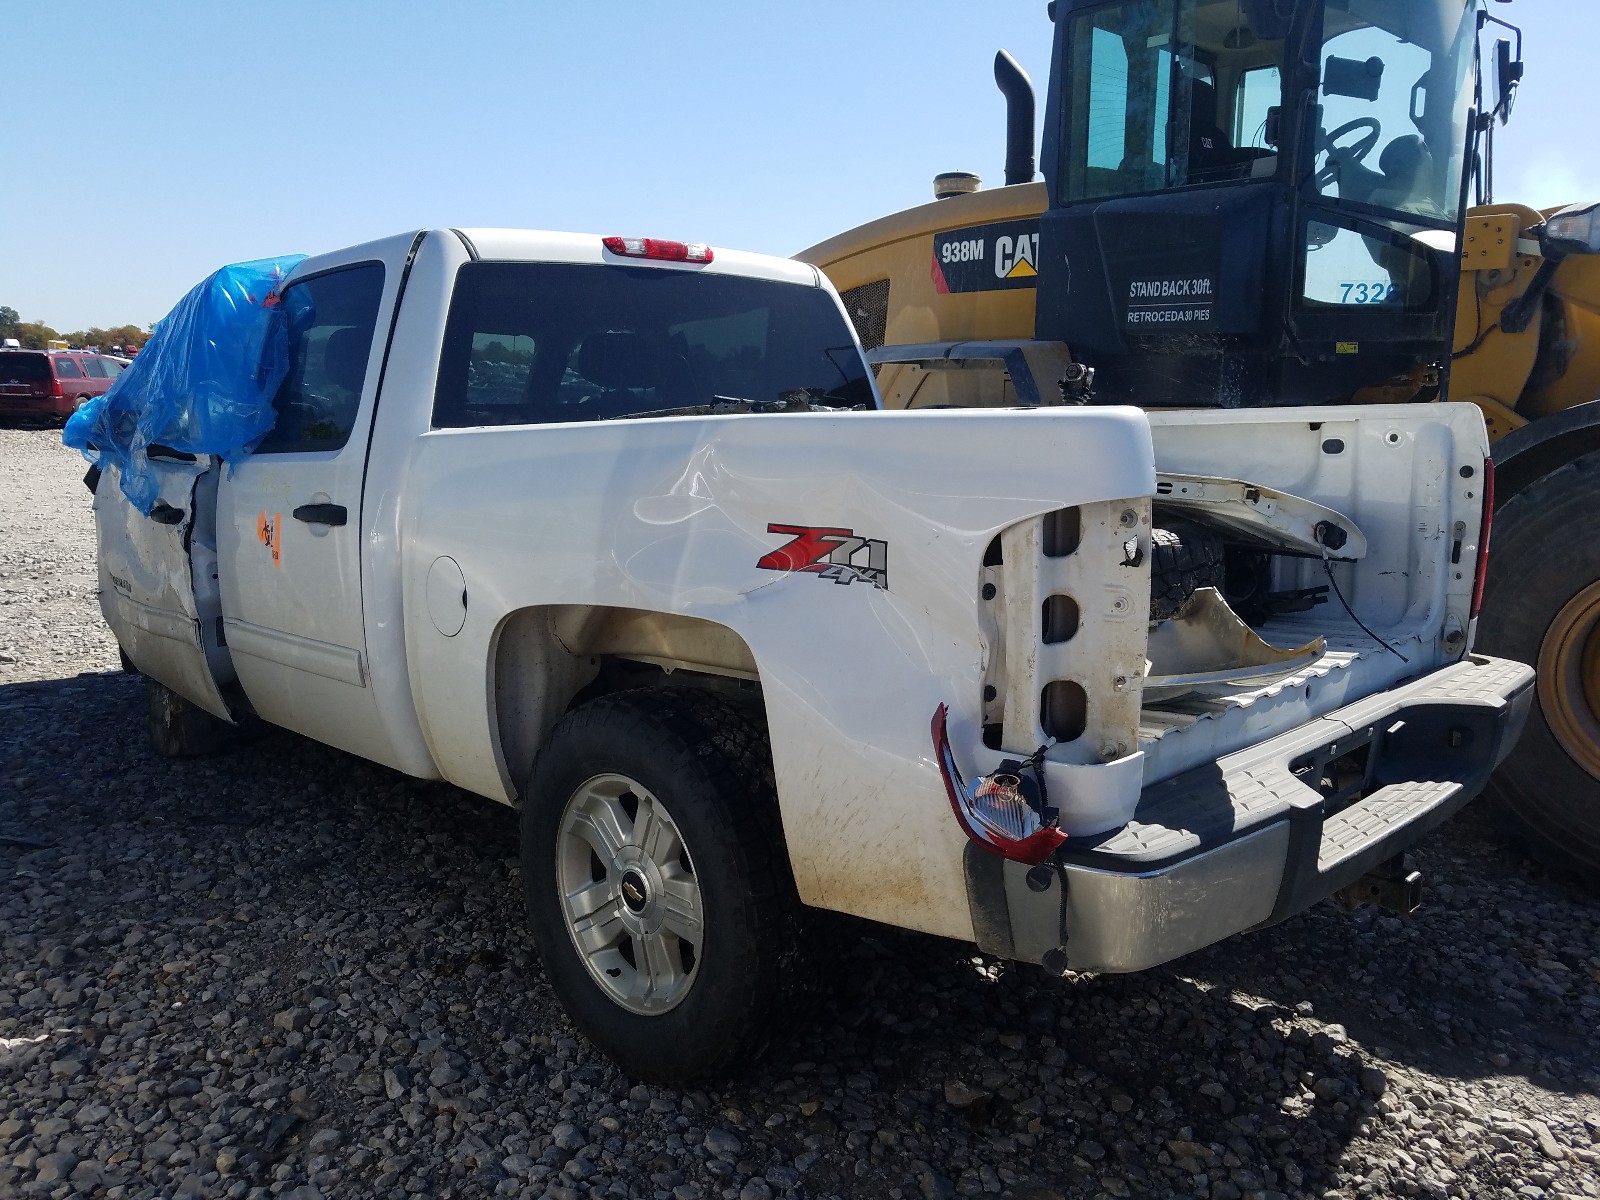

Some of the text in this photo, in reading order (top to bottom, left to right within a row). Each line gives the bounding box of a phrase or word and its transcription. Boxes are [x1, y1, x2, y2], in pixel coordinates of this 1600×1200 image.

[942, 239, 984, 263] 938M
[1129, 278, 1213, 297] STAND BACK 30ft.
[1127, 309, 1211, 323] RETROCEDA 30 PIES
[756, 523, 888, 573] Z71
